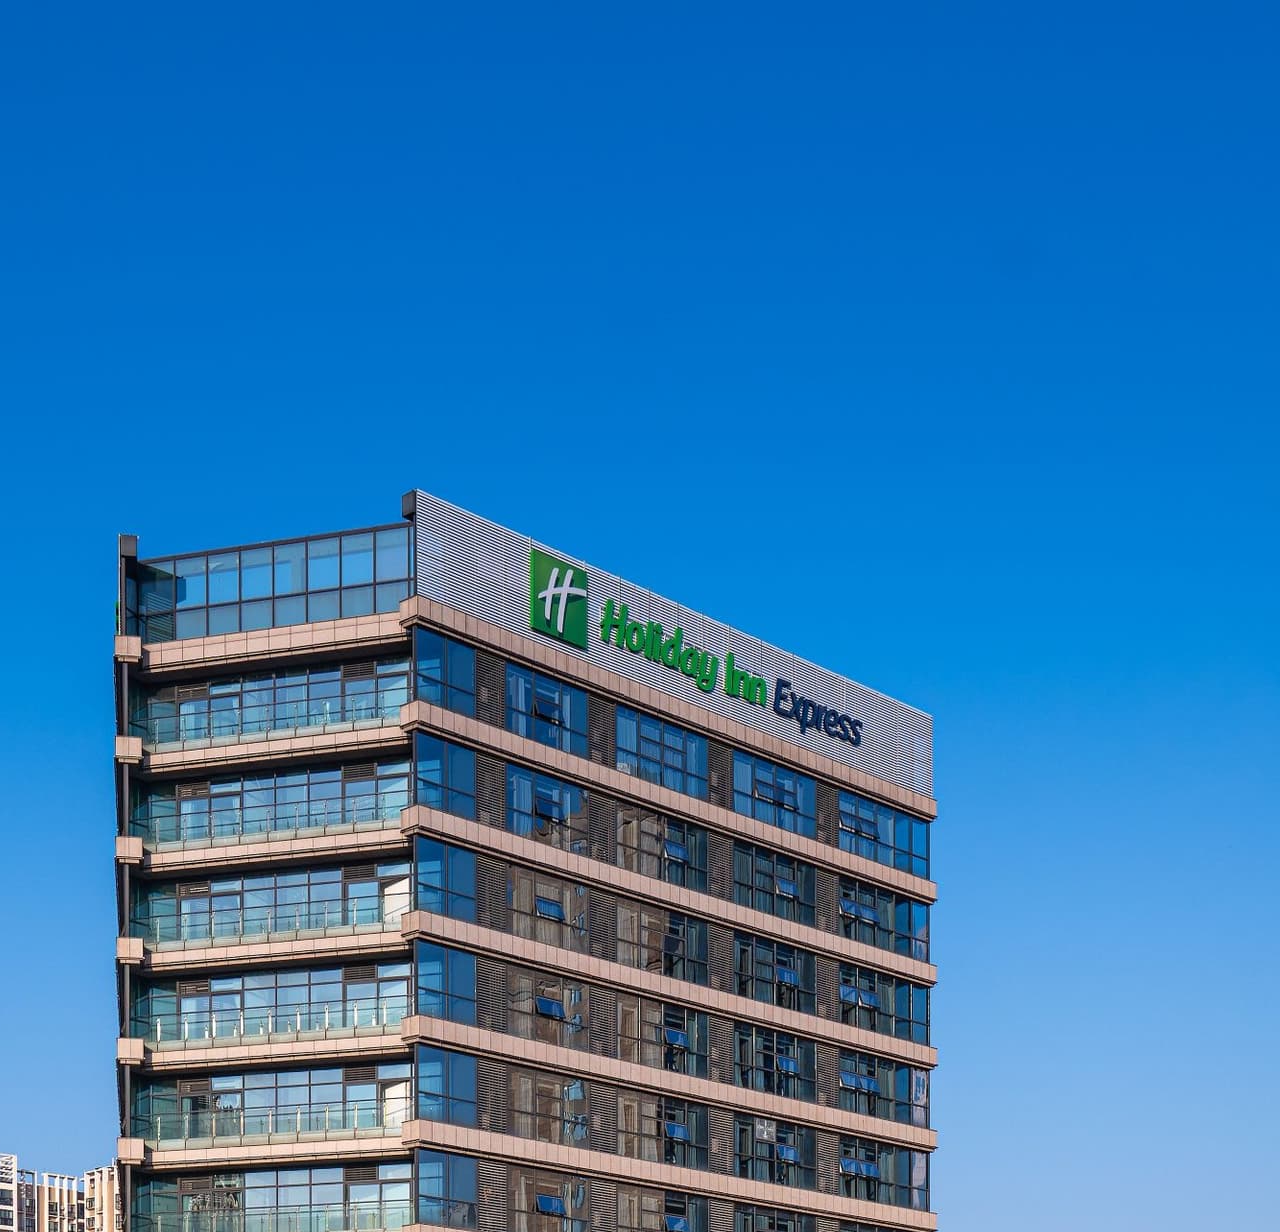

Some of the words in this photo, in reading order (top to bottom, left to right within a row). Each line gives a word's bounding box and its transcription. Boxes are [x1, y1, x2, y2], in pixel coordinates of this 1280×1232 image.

[600, 599, 719, 693] Holiday
[724, 652, 768, 707] Inn
[773, 678, 864, 745] Express
